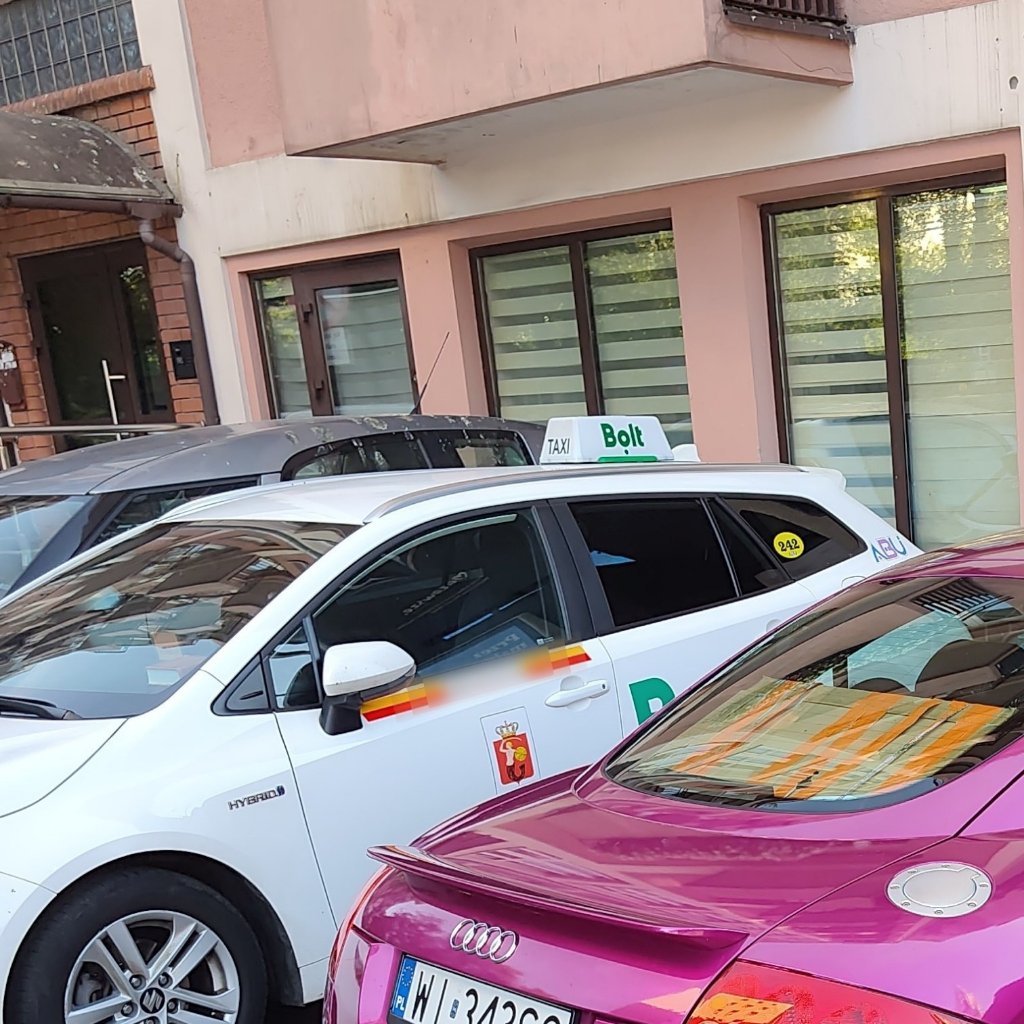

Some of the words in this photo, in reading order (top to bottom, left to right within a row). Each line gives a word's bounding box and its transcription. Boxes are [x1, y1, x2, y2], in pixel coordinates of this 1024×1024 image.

[547, 437, 571, 455] TAXI
[600, 423, 645, 455] Bolt
[778, 538, 800, 552] 242
[227, 787, 277, 811] HYBRID
[395, 996, 405, 1011] PL
